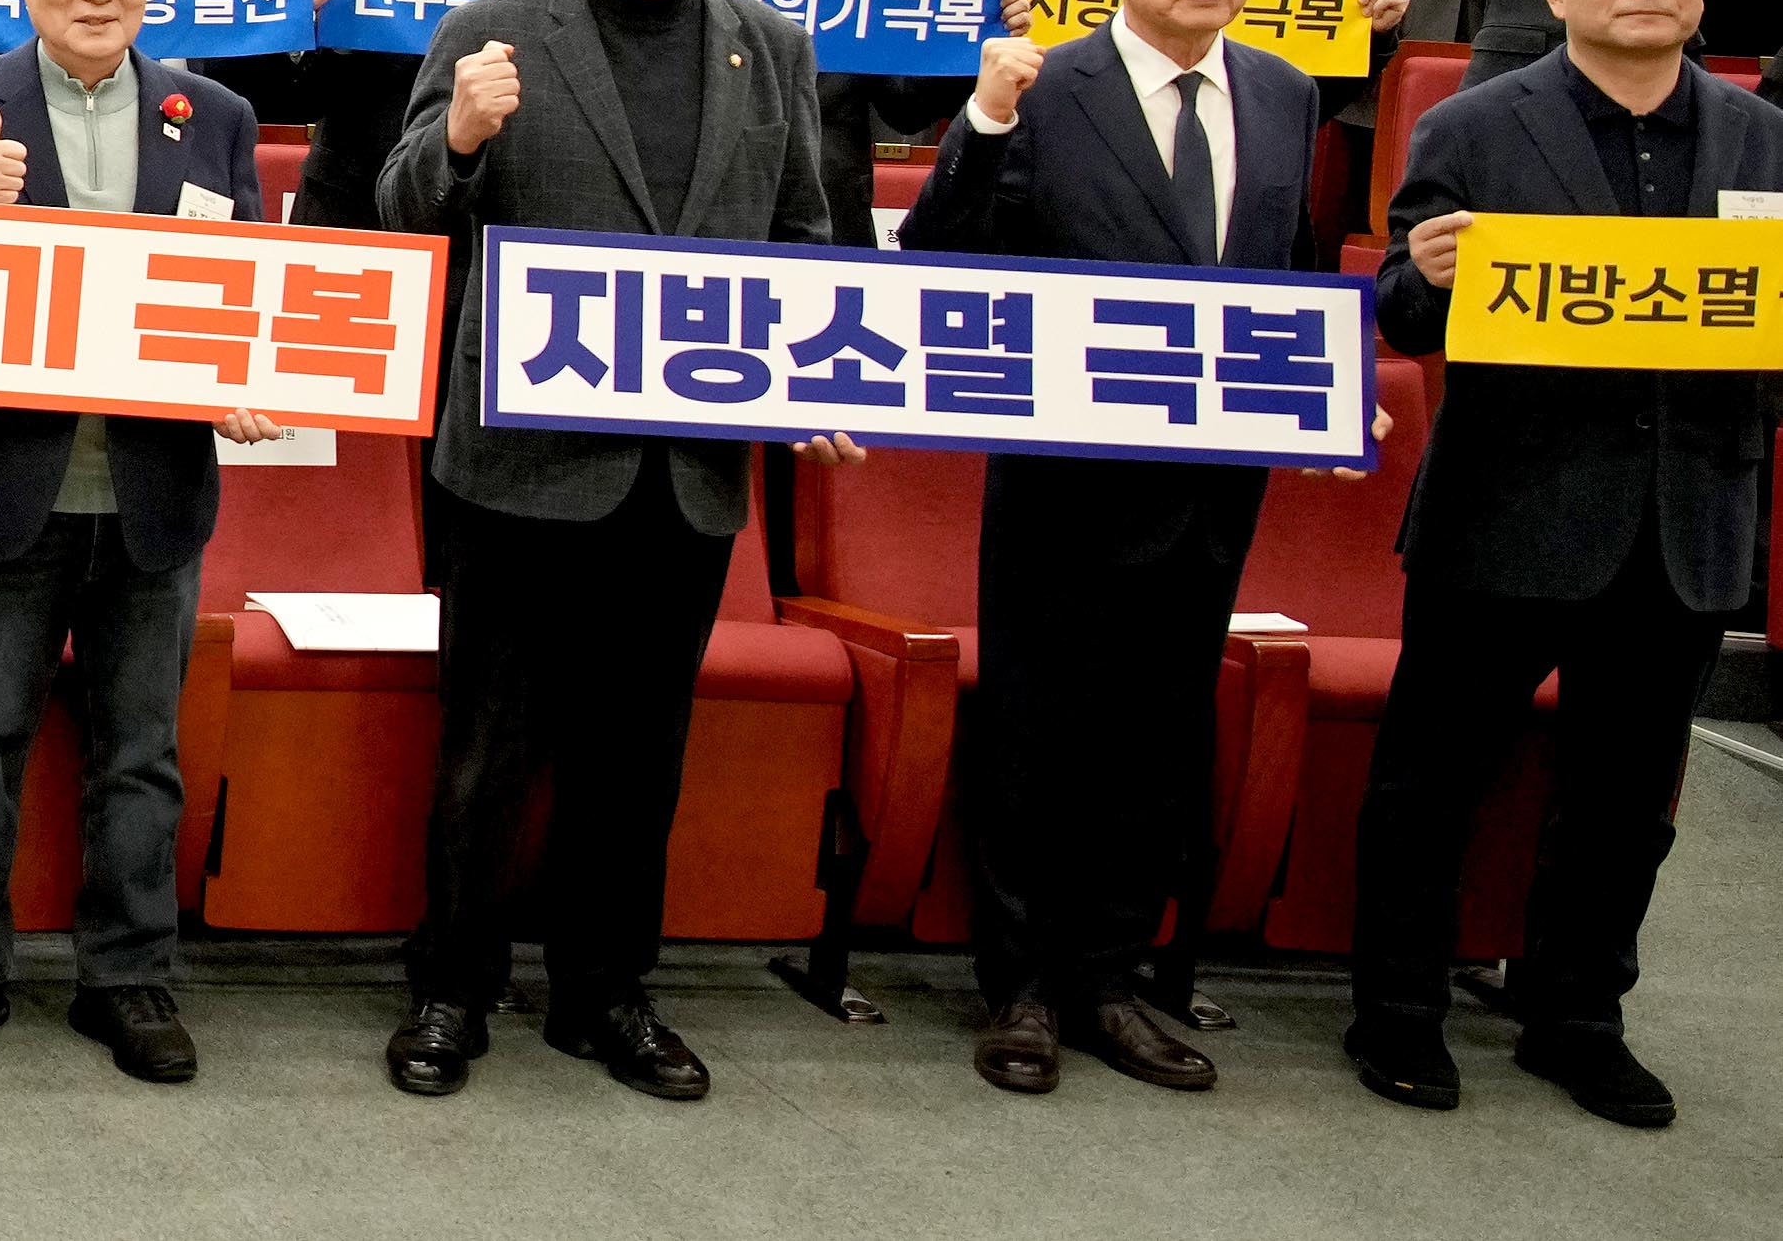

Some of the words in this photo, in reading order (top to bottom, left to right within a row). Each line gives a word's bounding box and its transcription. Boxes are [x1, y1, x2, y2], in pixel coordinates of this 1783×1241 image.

[133, 253, 397, 396] 극복
[521, 266, 1035, 418] 지방소멸
[1085, 298, 1334, 432] 극복
[1488, 262, 1759, 327] 지방소멸
